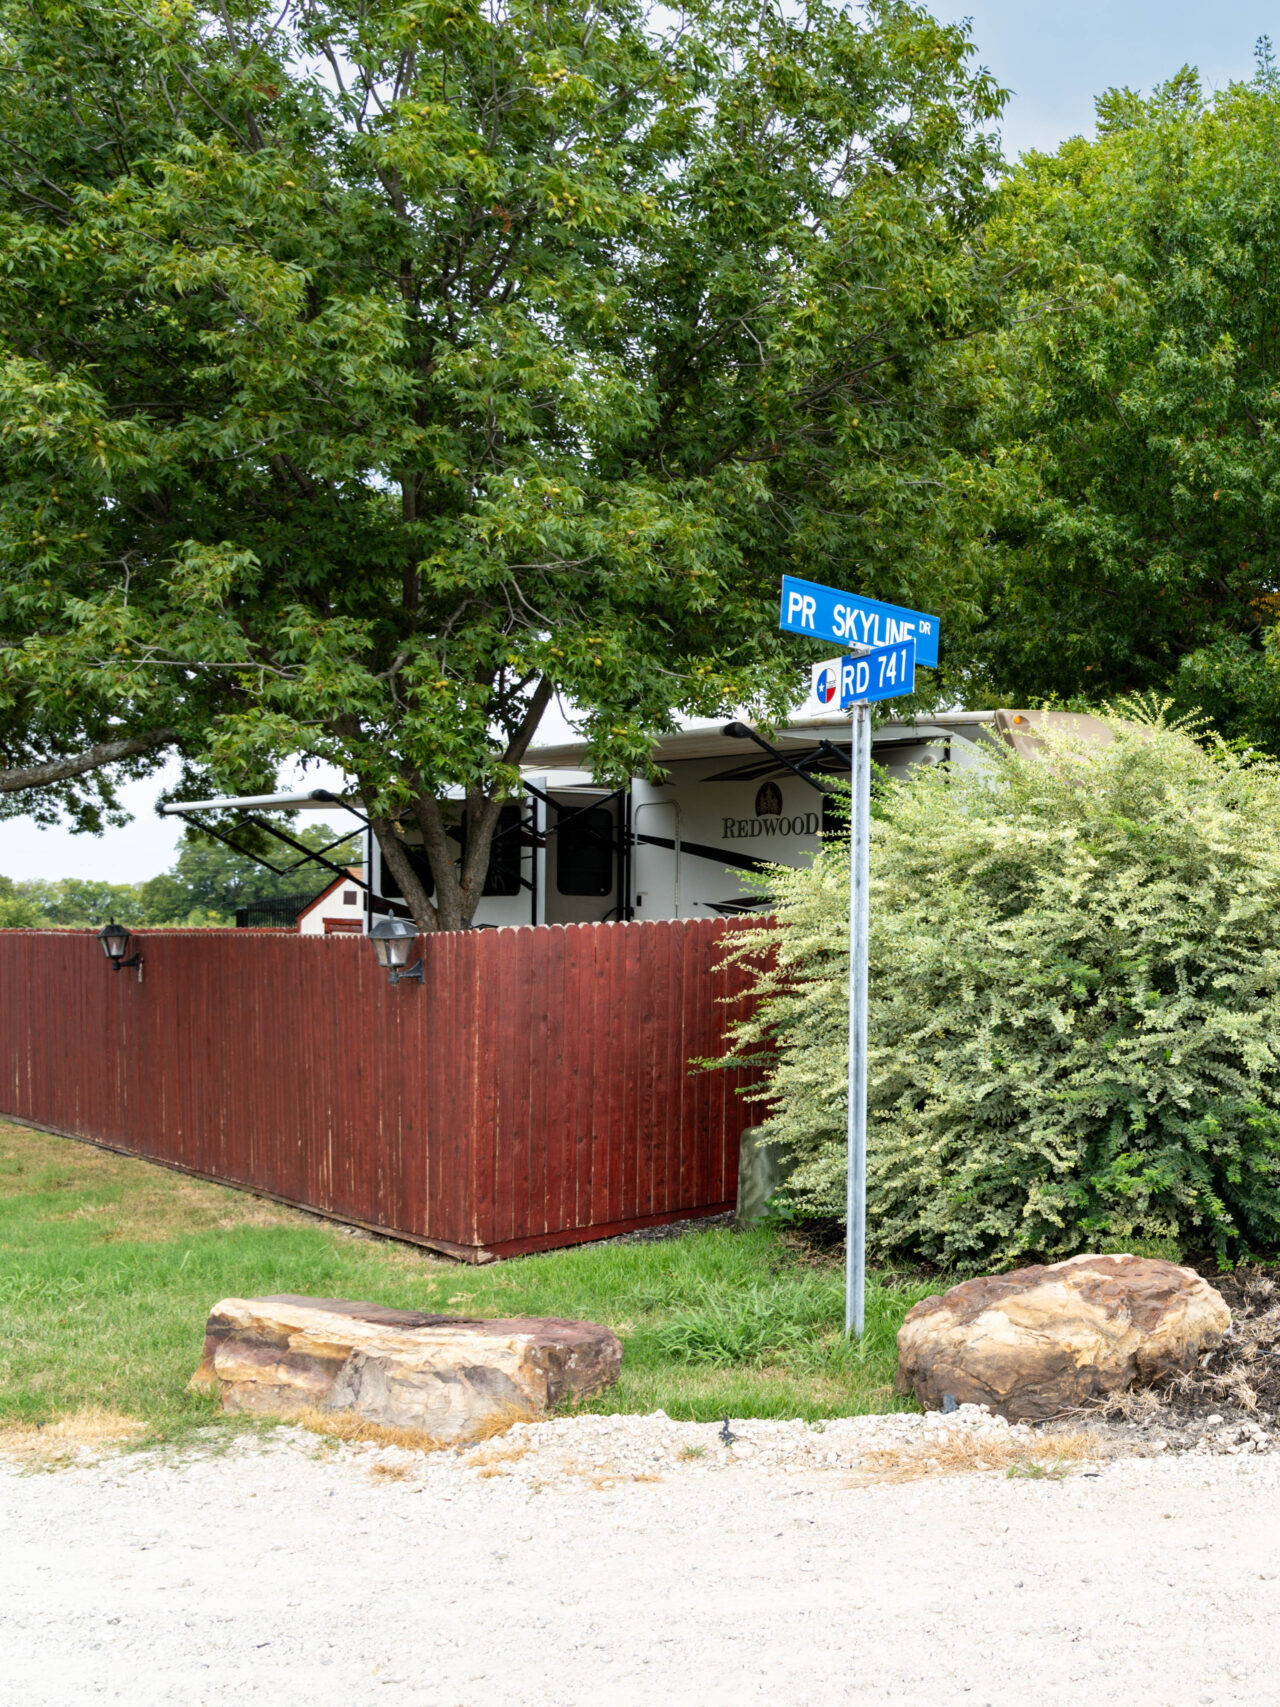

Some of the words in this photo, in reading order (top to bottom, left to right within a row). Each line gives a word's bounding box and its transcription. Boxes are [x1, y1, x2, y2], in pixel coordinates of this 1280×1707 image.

[787, 592, 816, 629] PR
[918, 620, 931, 635] DR
[842, 661, 869, 697] RD
[878, 649, 907, 687] 741
